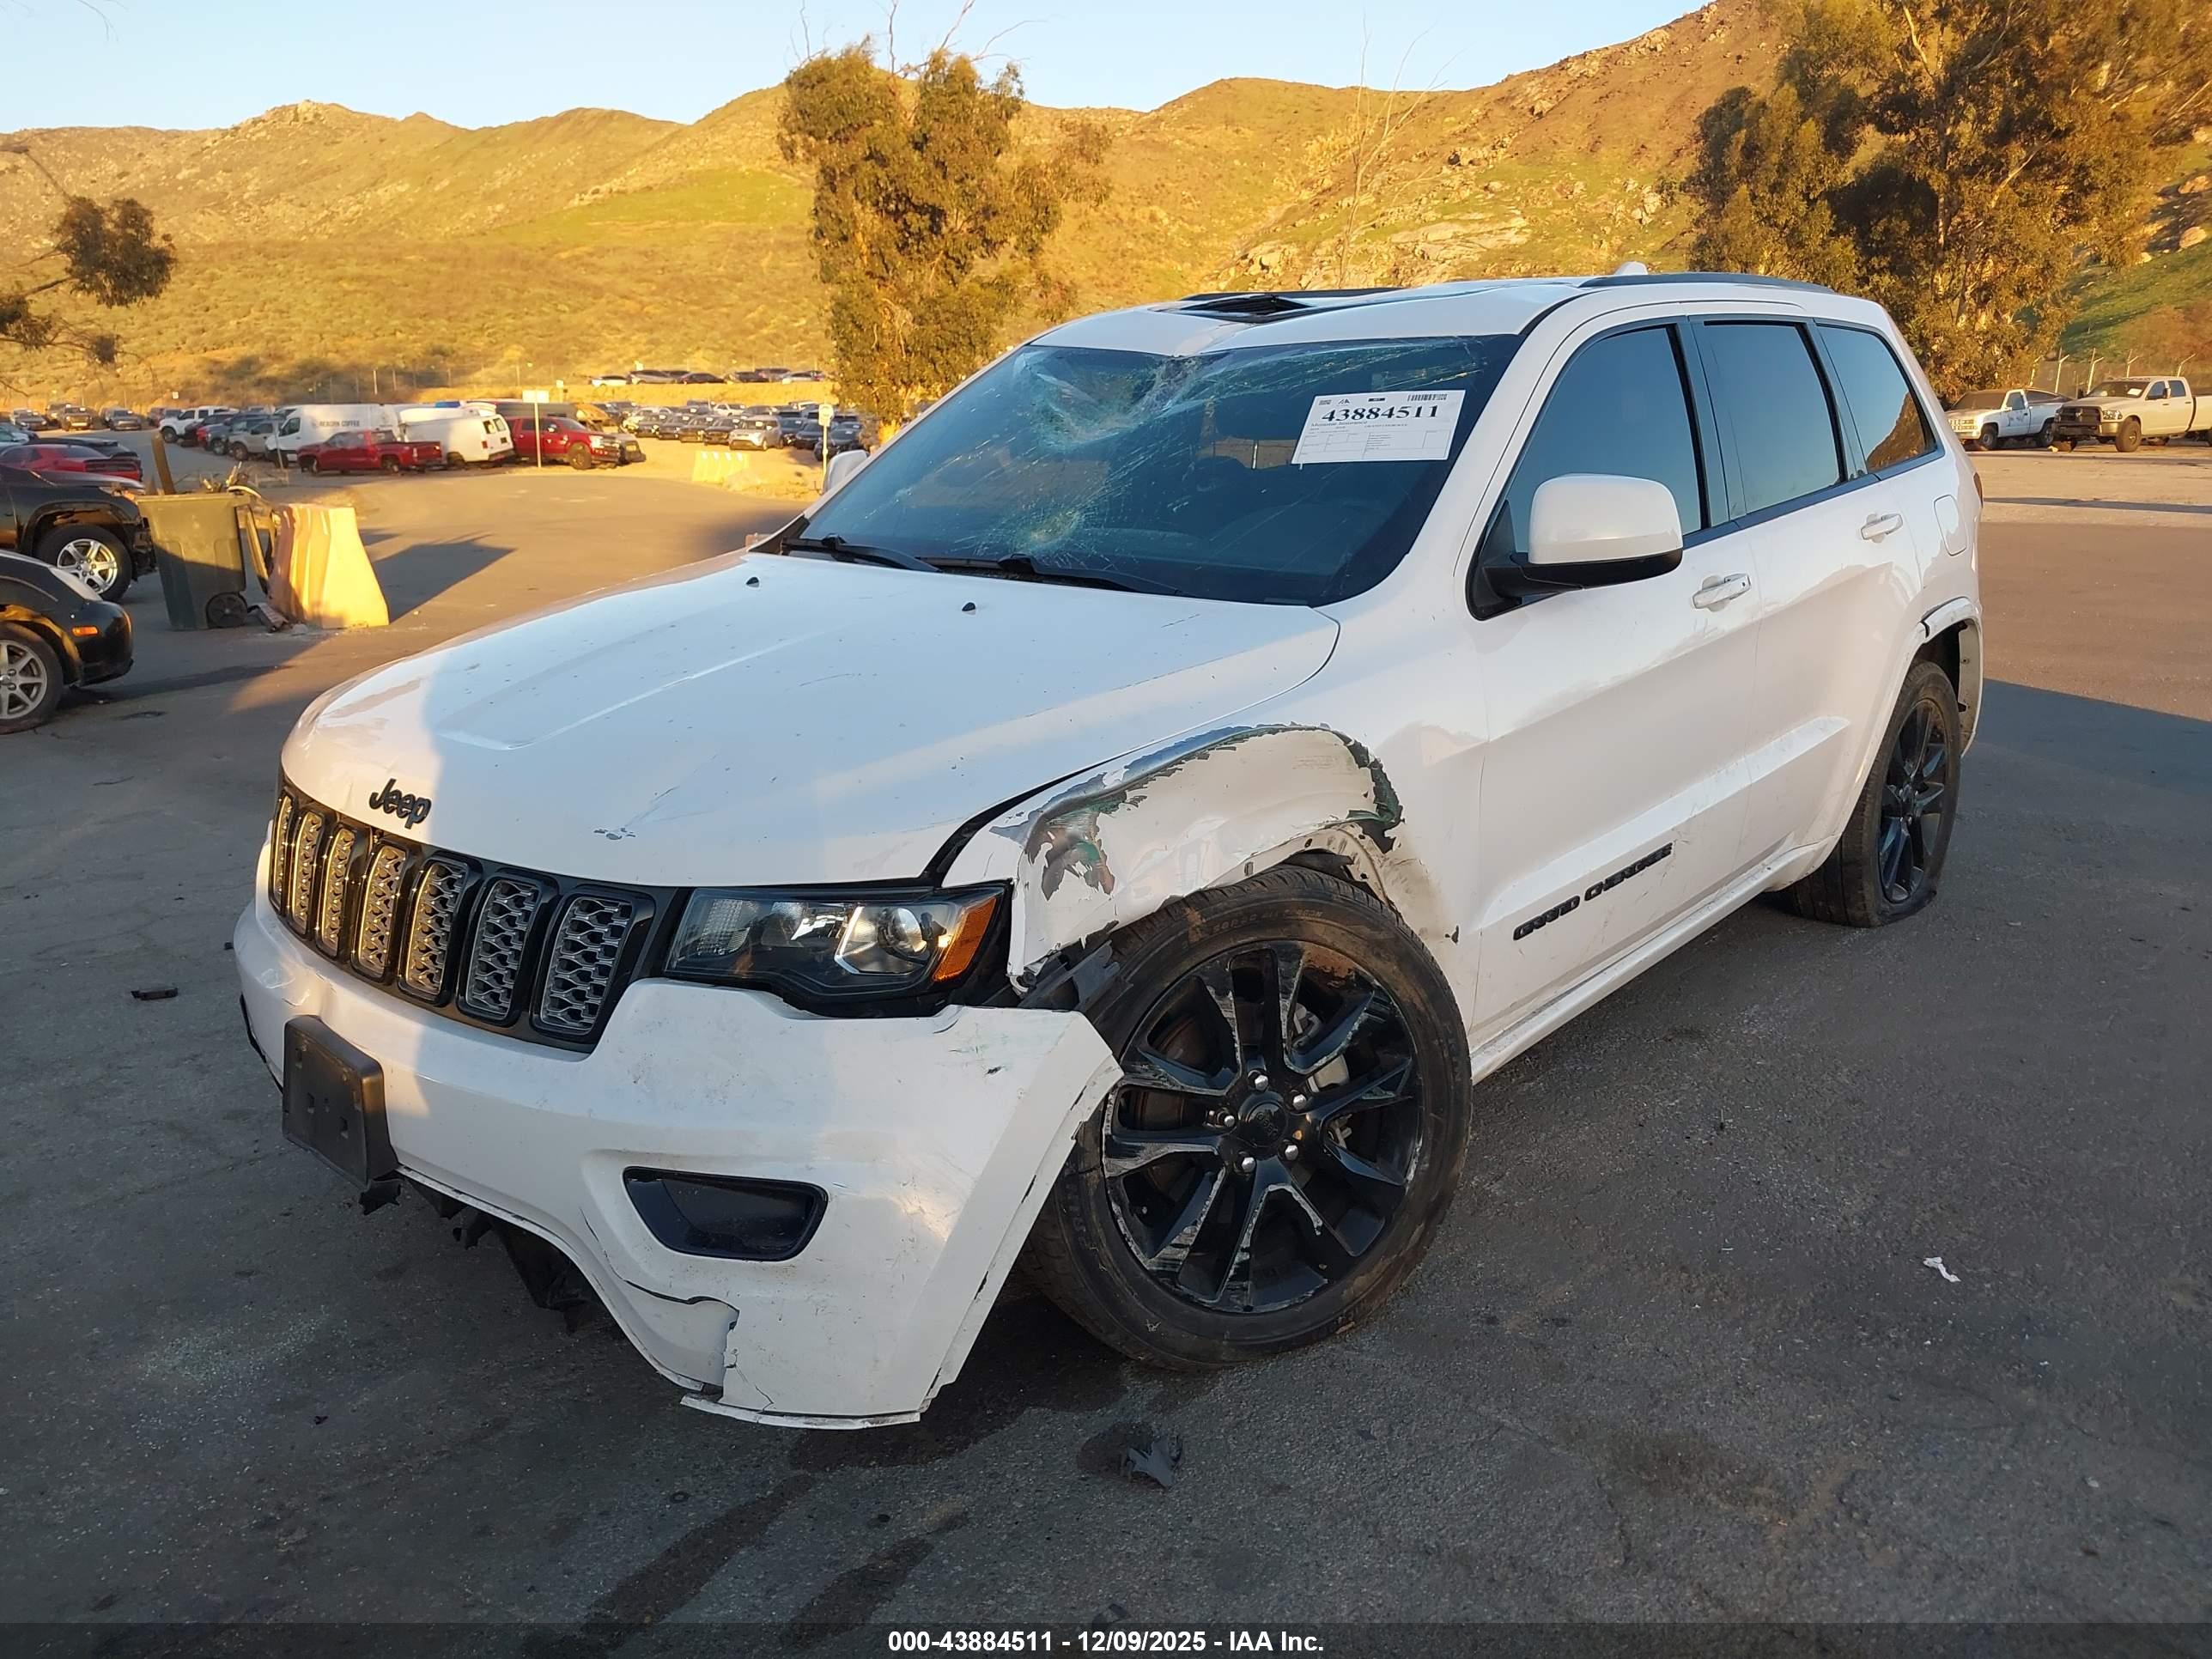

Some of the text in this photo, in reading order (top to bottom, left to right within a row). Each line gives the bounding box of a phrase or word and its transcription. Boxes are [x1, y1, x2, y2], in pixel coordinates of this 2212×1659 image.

[1322, 404, 1439, 422] 43884511
[369, 778, 432, 830] Jeep
[1513, 842, 1673, 940] GRAND CHEROKEE
